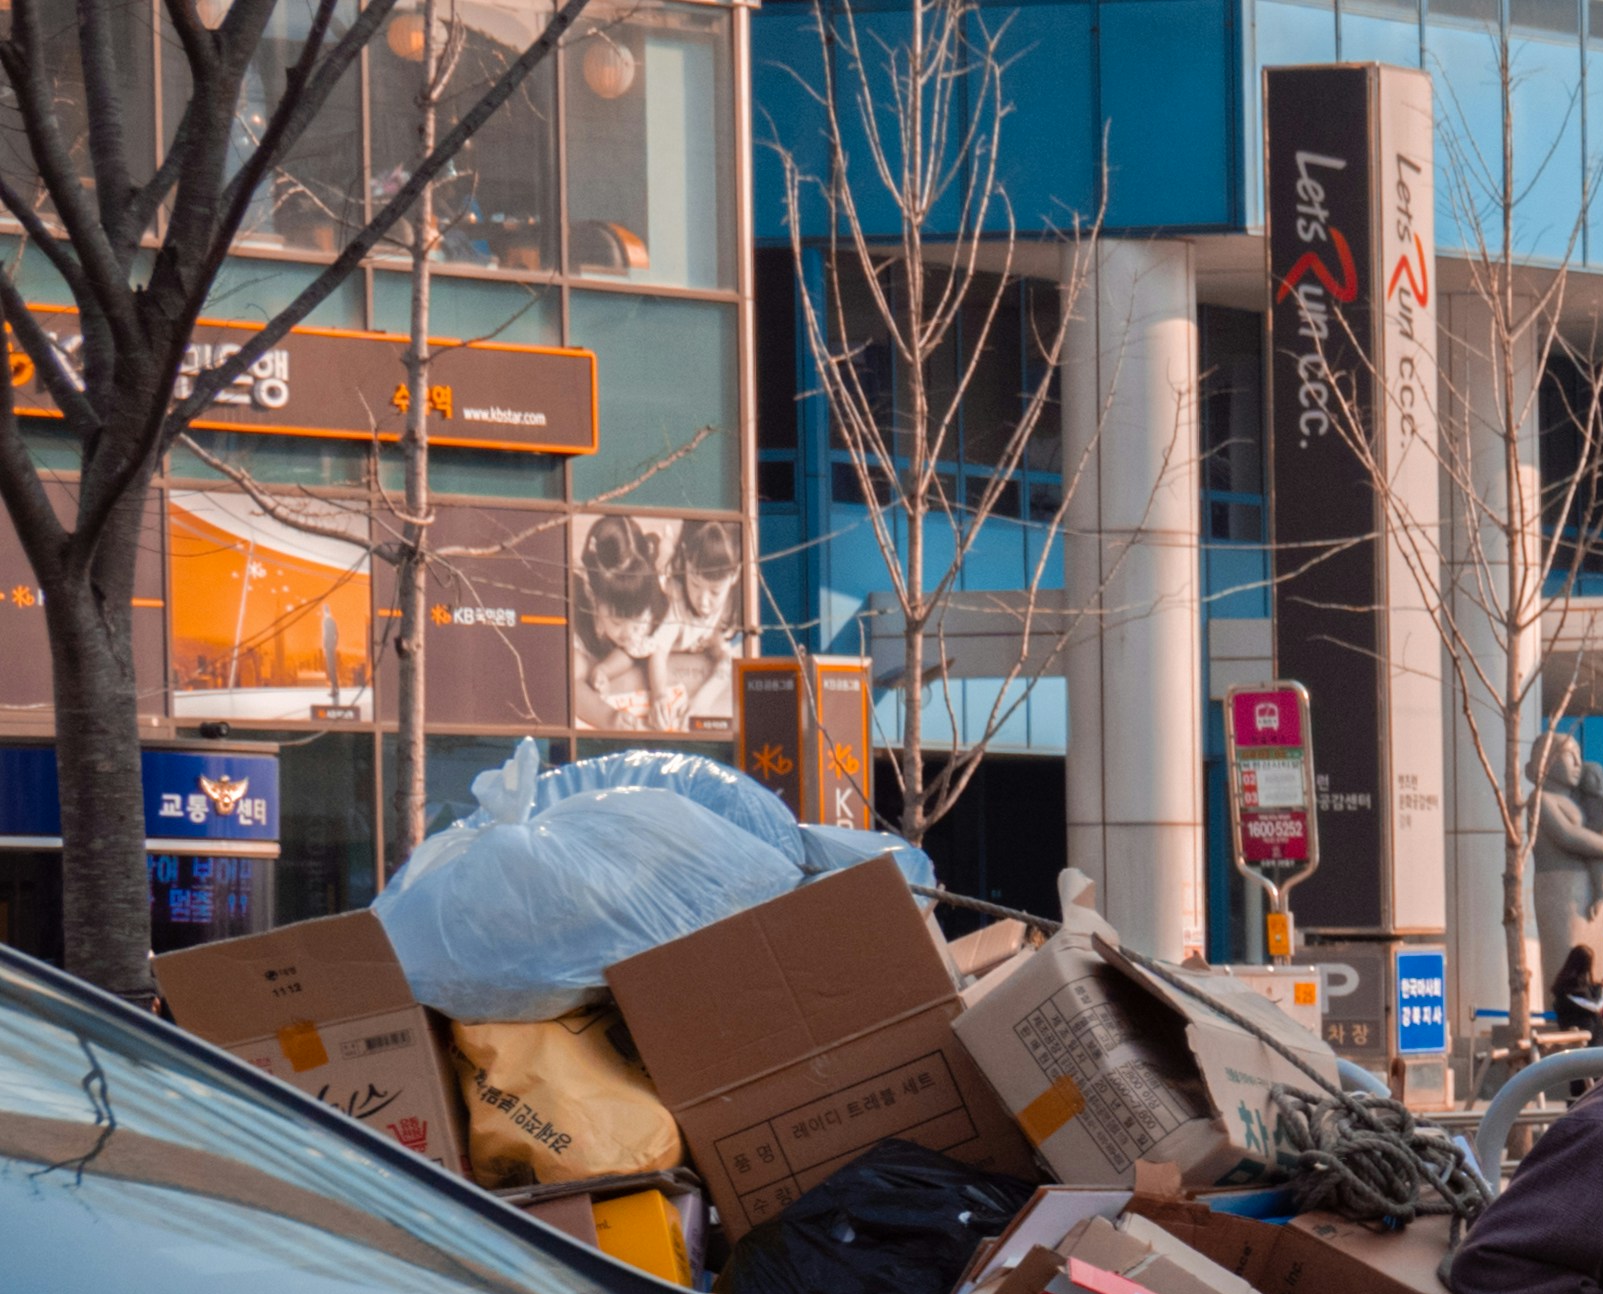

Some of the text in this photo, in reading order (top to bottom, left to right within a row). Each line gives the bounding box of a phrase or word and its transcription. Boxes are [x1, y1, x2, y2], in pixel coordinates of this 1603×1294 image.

[462, 405, 547, 426] www.kbstar.com
[158, 793, 267, 826] 교통 센터
[1317, 963, 1360, 1014] P
[1401, 977, 1442, 999] 한국마사회
[1402, 1005, 1442, 1028] 강북지사
[791, 1111, 843, 1140] 레이디
[903, 1071, 936, 1097] 세트
